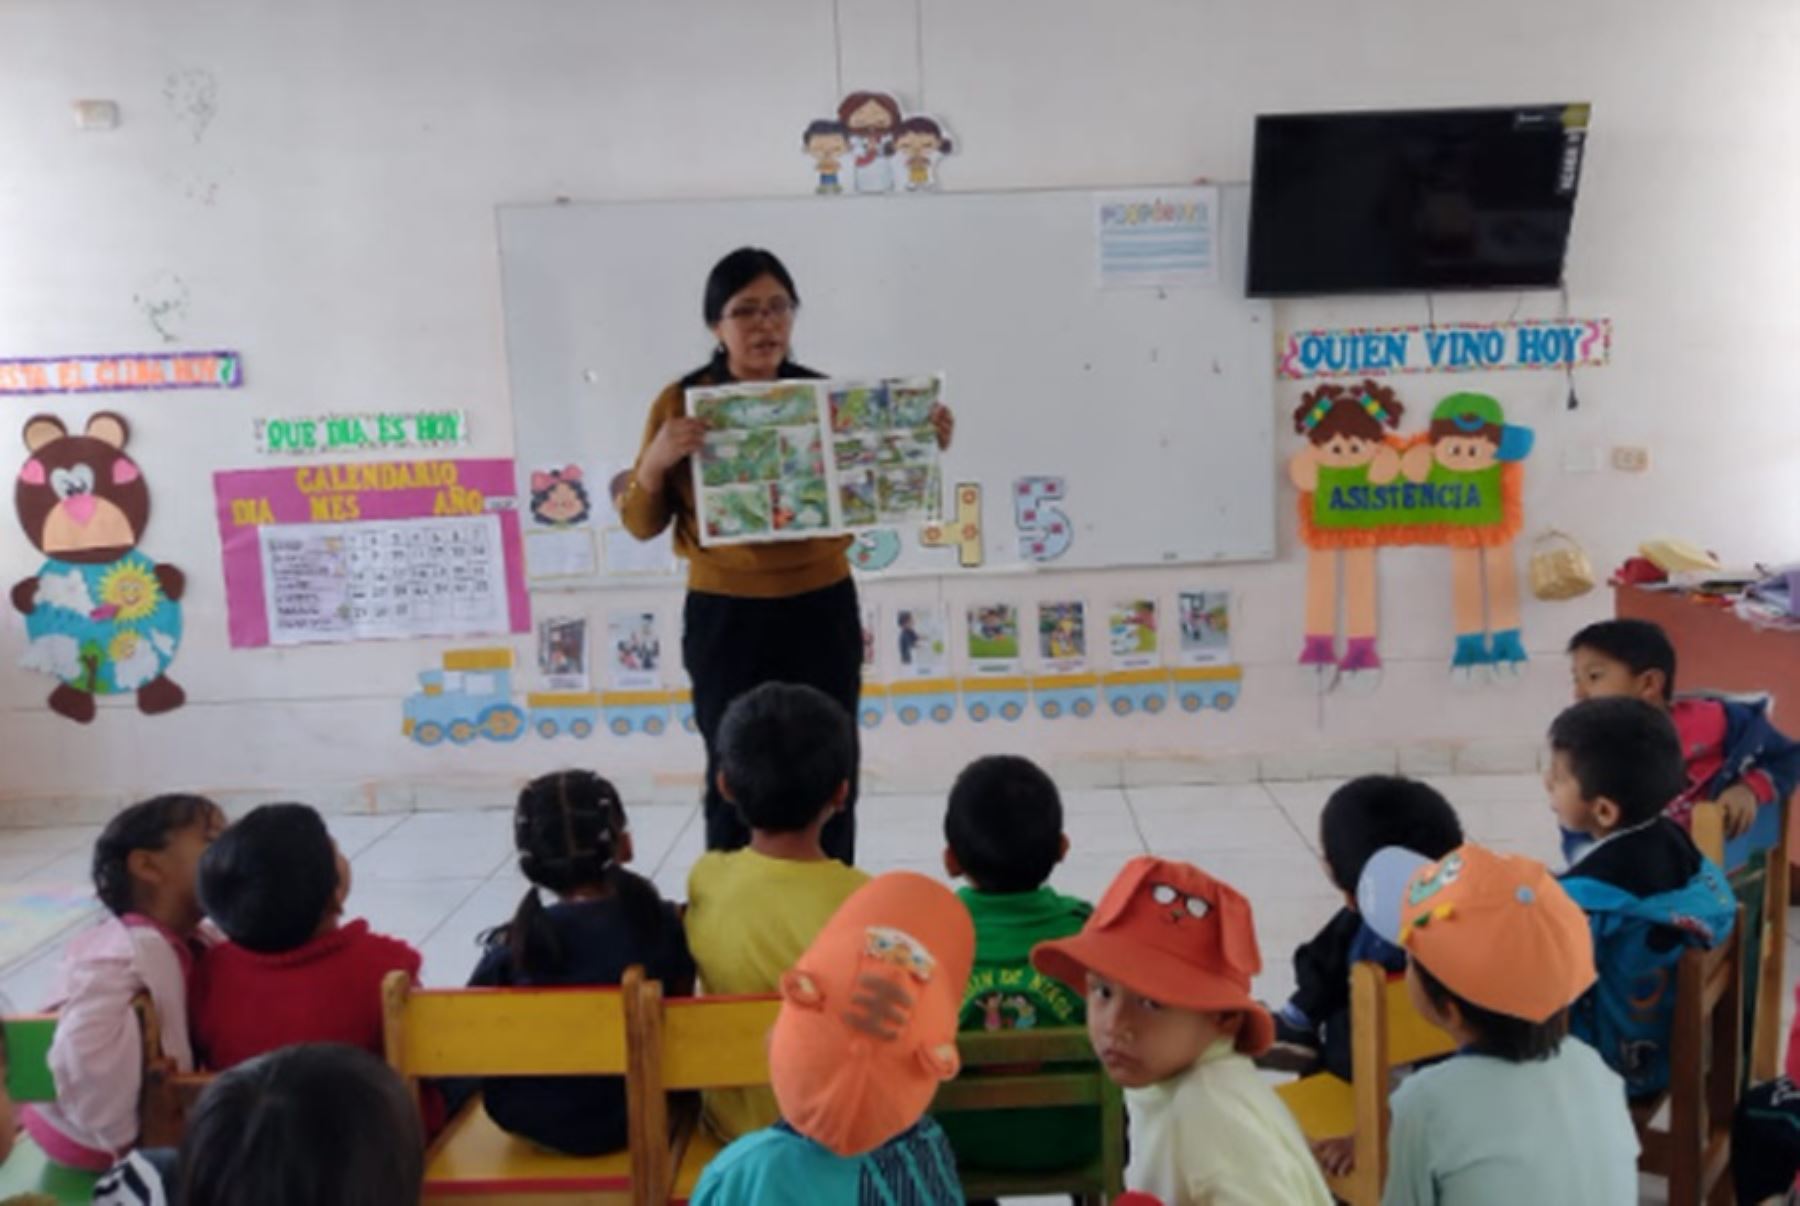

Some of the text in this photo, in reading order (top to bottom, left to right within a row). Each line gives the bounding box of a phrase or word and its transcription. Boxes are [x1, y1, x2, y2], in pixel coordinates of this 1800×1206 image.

[1425, 329, 1505, 366] VINO
[267, 412, 461, 449] QUE DIA ES HOY
[295, 462, 458, 492] CALENDARIO
[231, 486, 485, 525] DIA MES AÑO
[1329, 483, 1482, 513] ASISTENCIA
[920, 482, 984, 568] 4
[1012, 476, 1074, 562] 5
